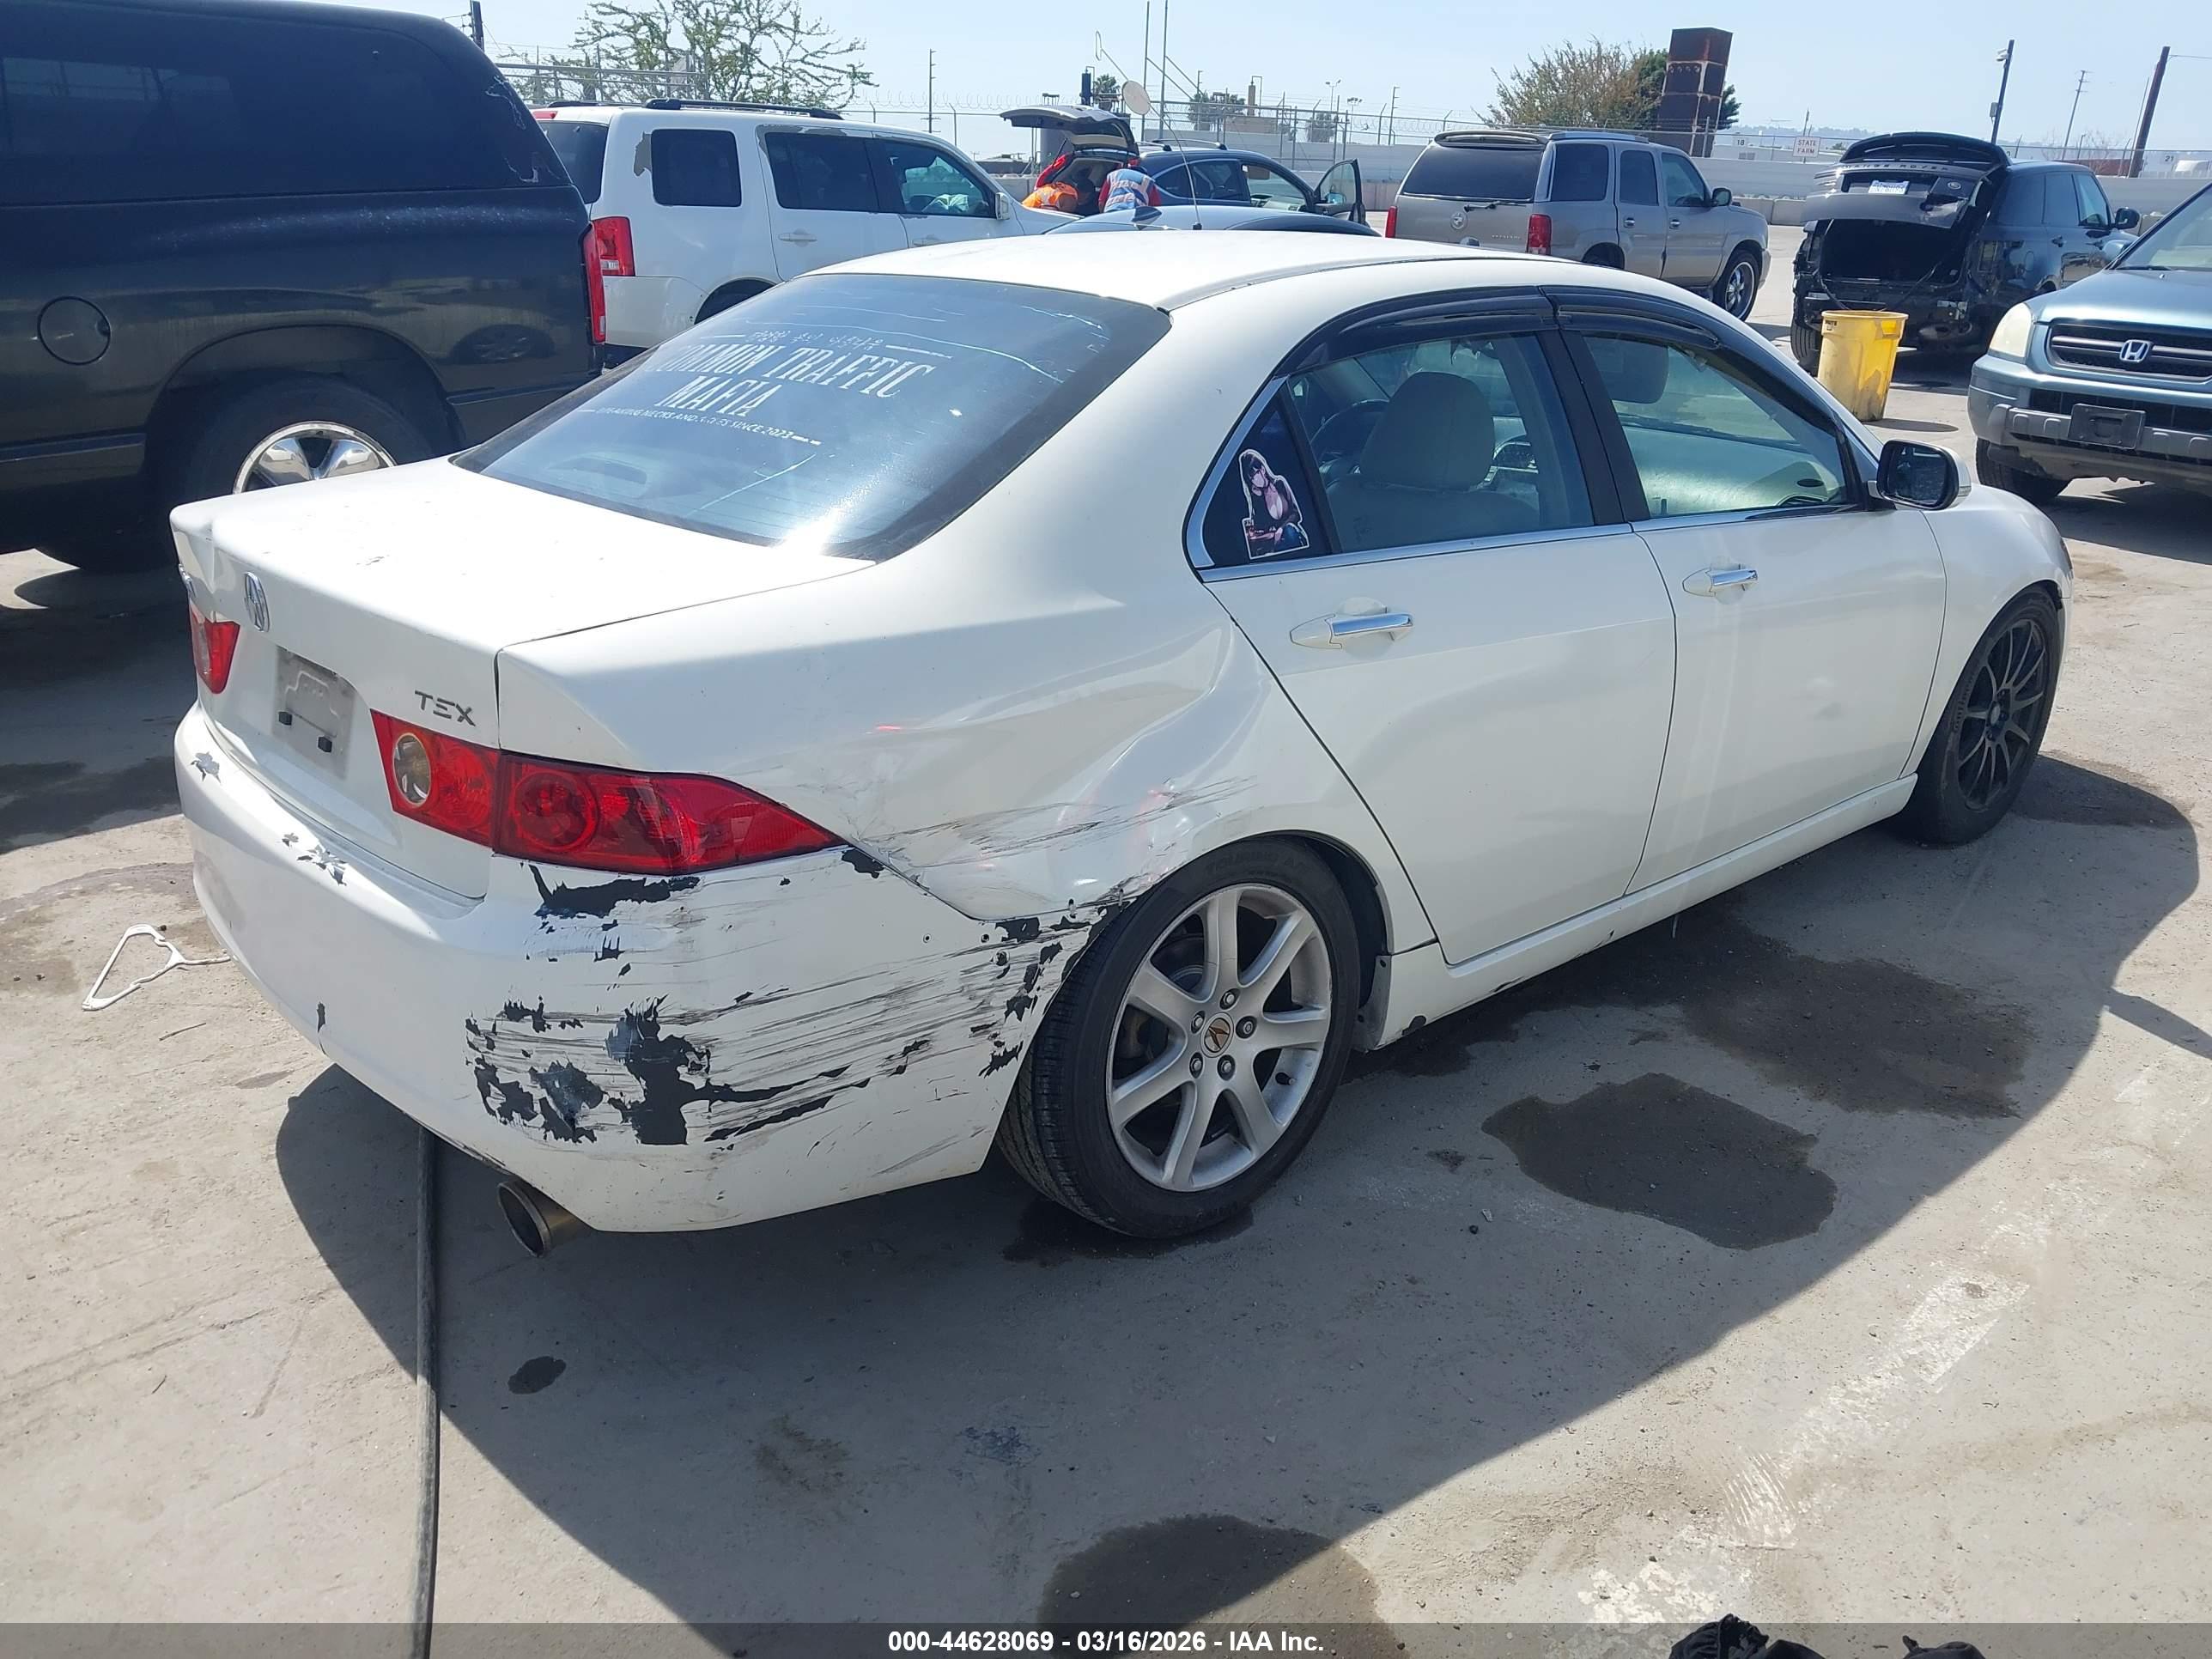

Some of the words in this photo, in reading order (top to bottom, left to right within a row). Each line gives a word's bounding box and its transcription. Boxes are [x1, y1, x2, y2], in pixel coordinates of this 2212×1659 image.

[762, 347, 937, 398] TRAFFIC
[653, 375, 782, 416] MAFIA
[730, 420, 764, 434] SINCE
